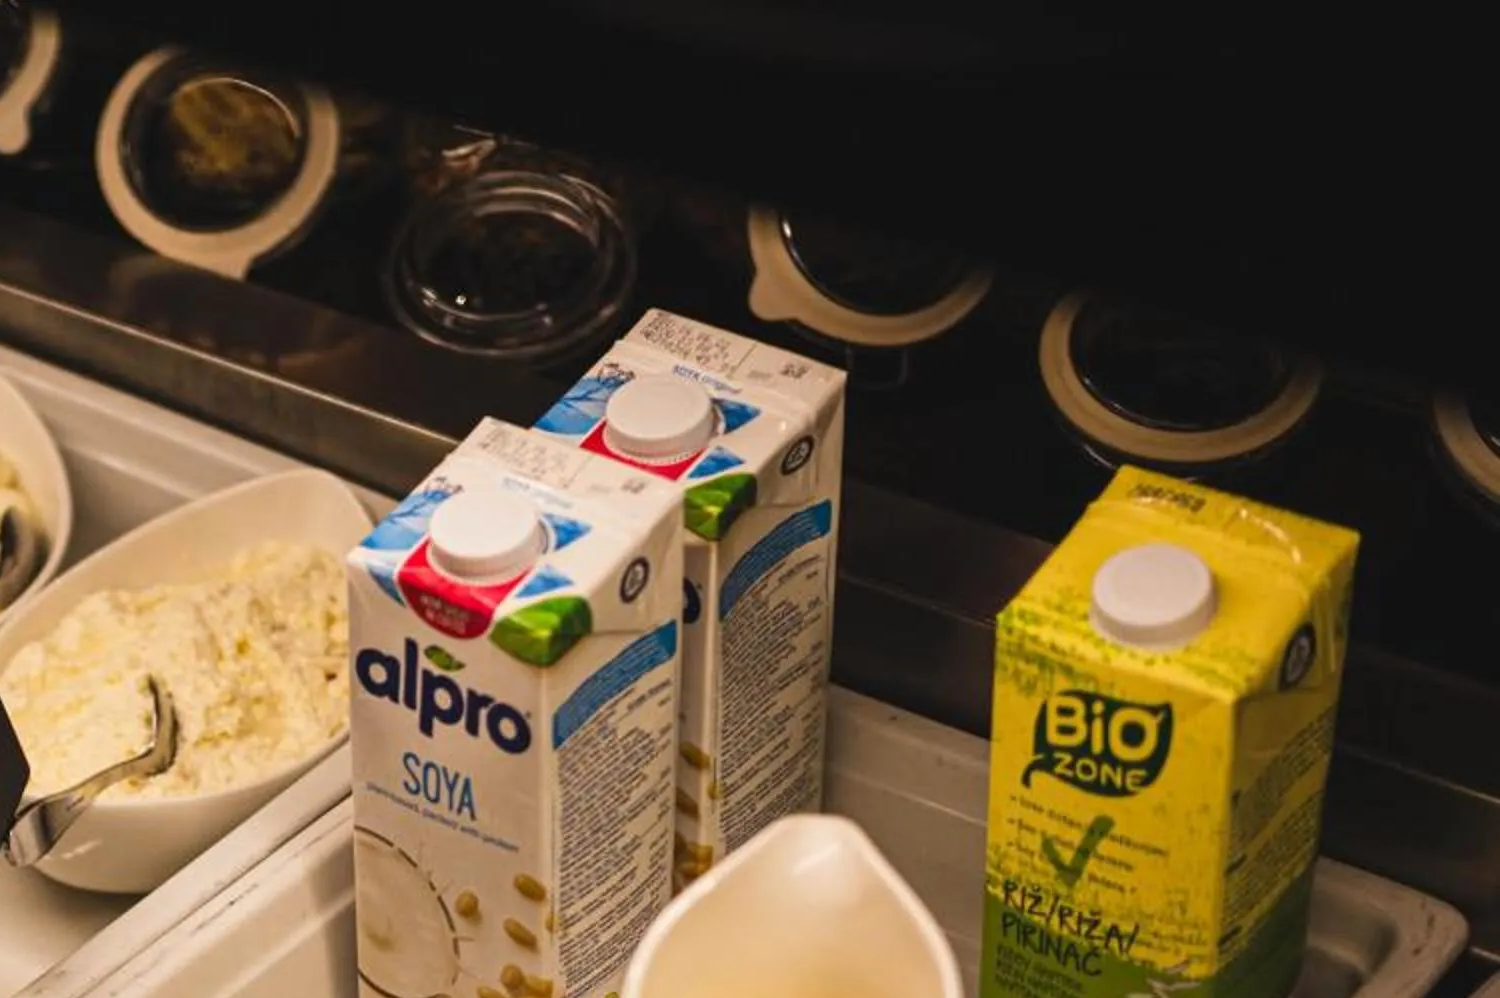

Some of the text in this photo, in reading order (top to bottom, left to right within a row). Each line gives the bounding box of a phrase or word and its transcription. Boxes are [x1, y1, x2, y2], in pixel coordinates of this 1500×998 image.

[355, 637, 532, 755] alpro
[402, 751, 476, 822] SOYA
[1052, 752, 1148, 793] ZONE
[1000, 909, 1104, 978] PIRINAČ
